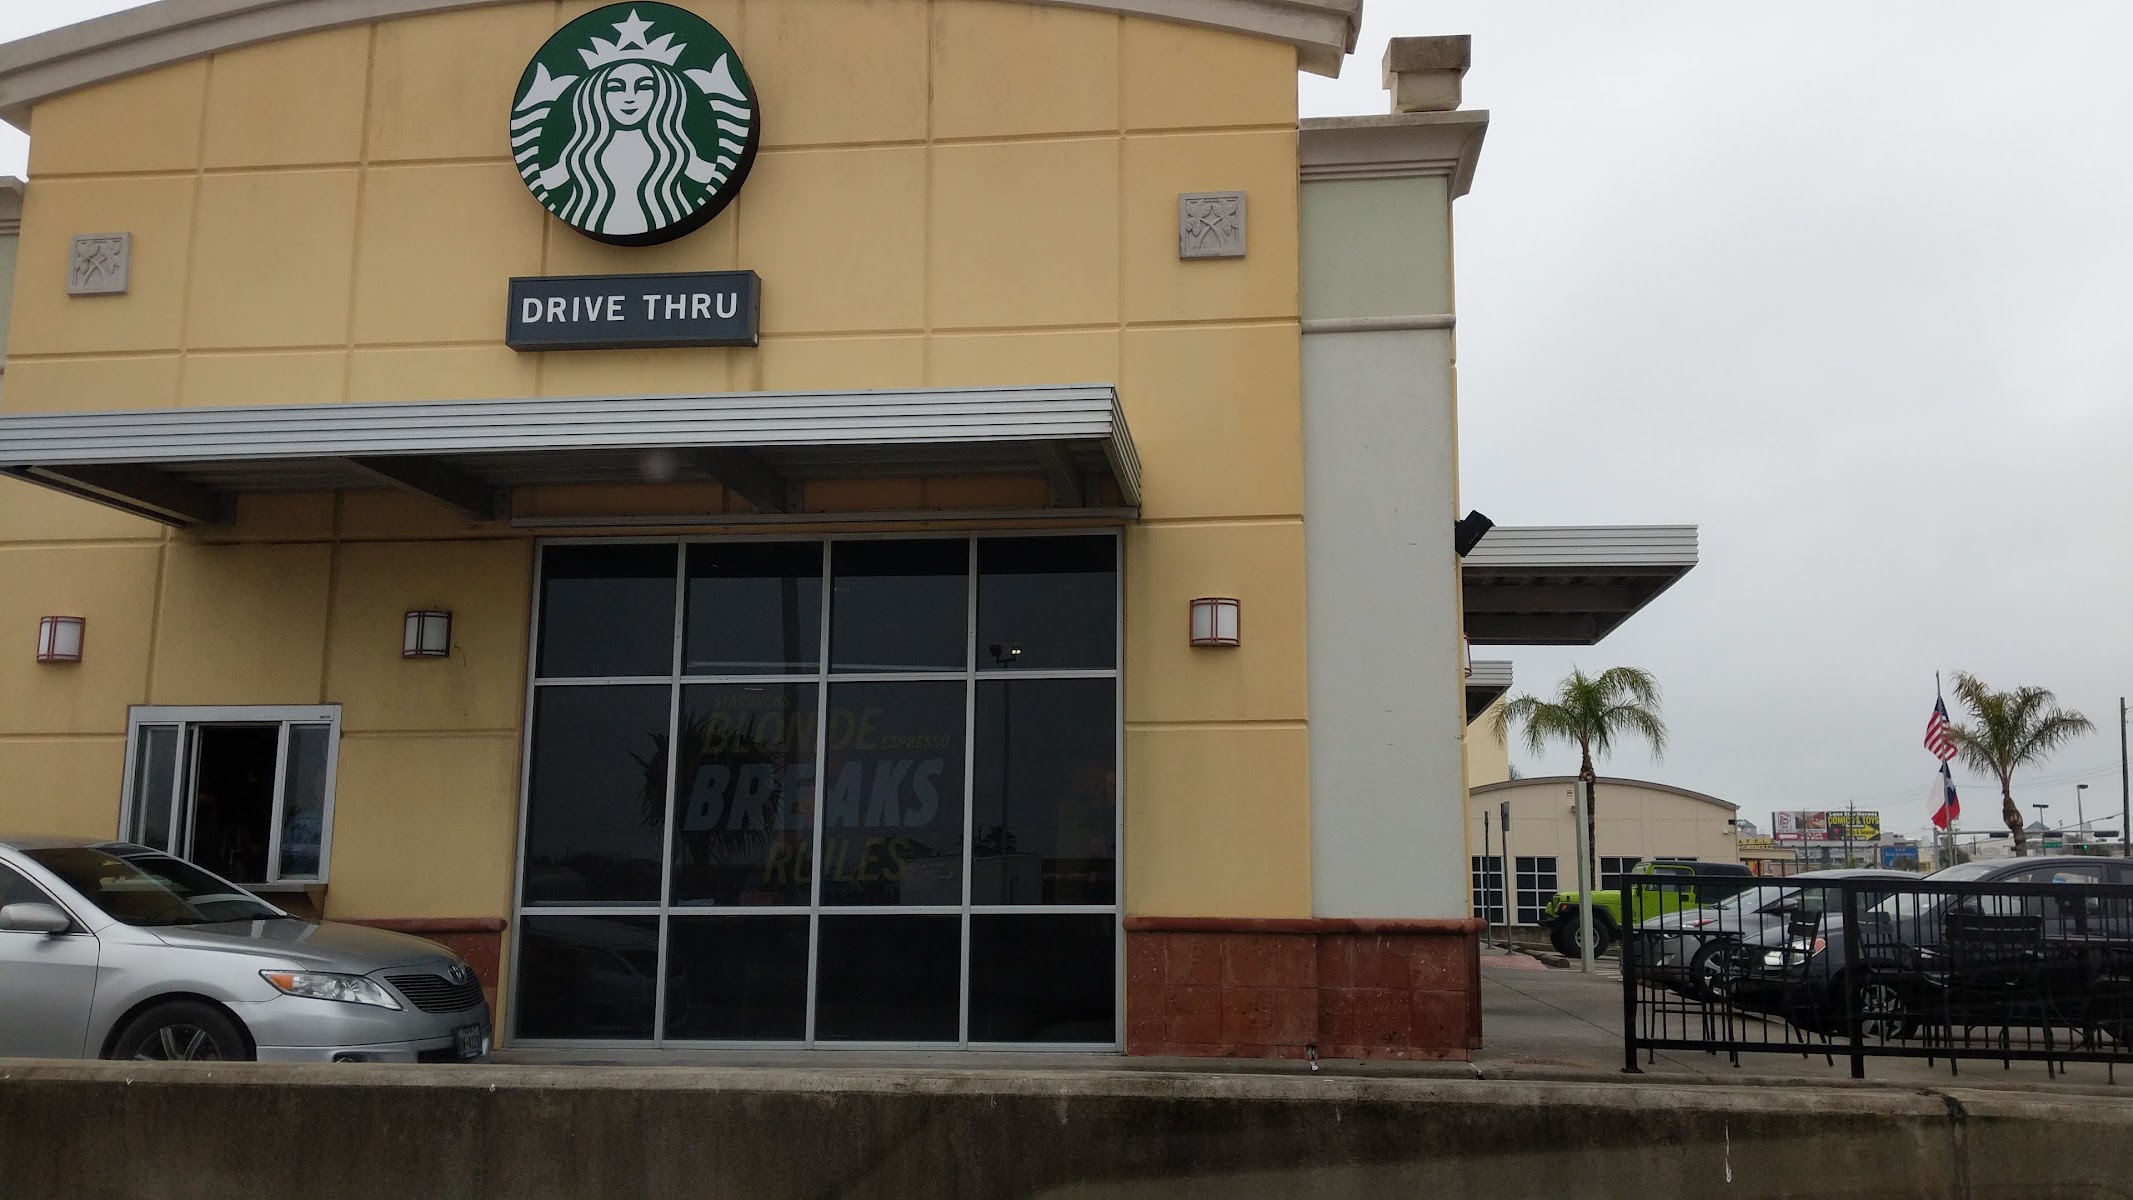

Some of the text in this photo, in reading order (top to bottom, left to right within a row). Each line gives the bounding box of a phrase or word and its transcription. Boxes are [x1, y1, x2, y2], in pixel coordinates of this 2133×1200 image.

[521, 292, 738, 323] DRIVE THRU
[702, 706, 884, 754] BLONDE
[683, 758, 945, 832] BREAKS
[1863, 816, 1880, 825] TOYS
[763, 835, 914, 885] RULES
